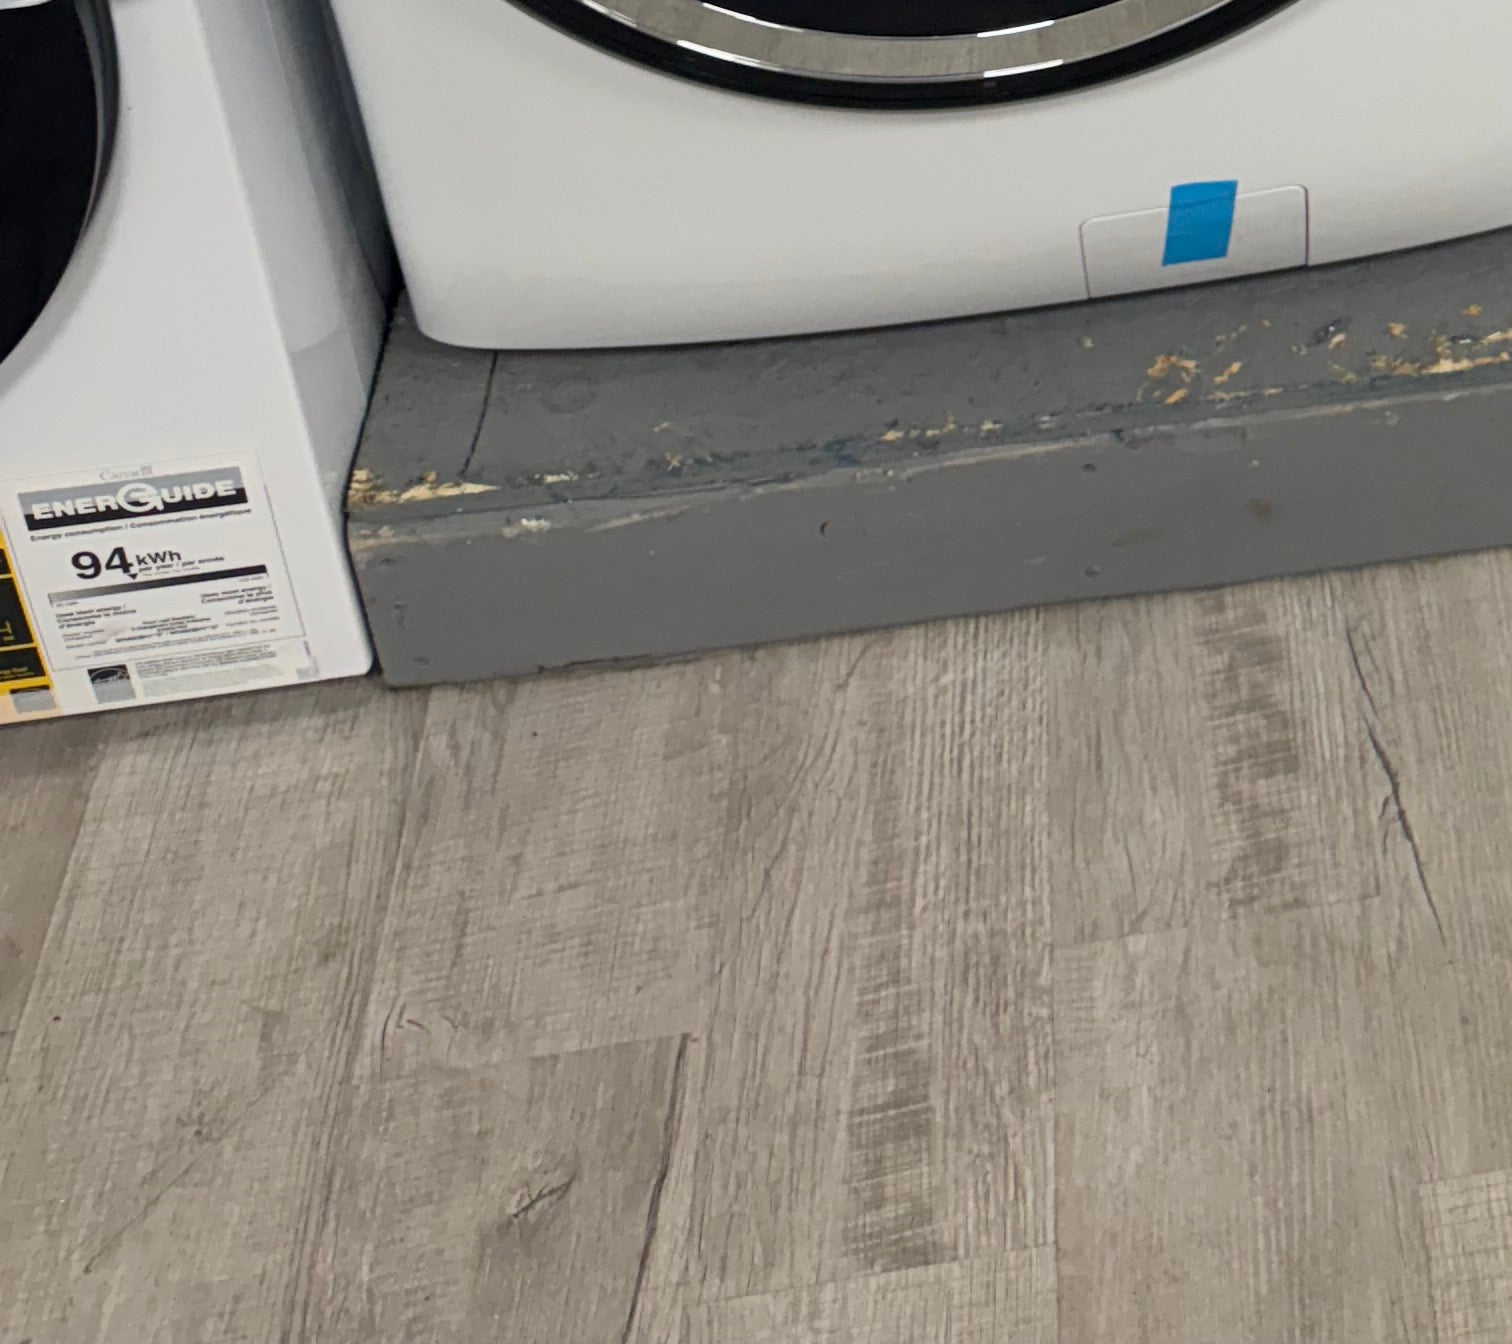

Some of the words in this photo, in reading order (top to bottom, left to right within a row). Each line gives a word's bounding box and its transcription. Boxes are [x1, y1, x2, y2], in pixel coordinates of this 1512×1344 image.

[31, 479, 237, 521] ENERGUIDE
[71, 546, 134, 580] 94
[135, 550, 182, 566] kWh
